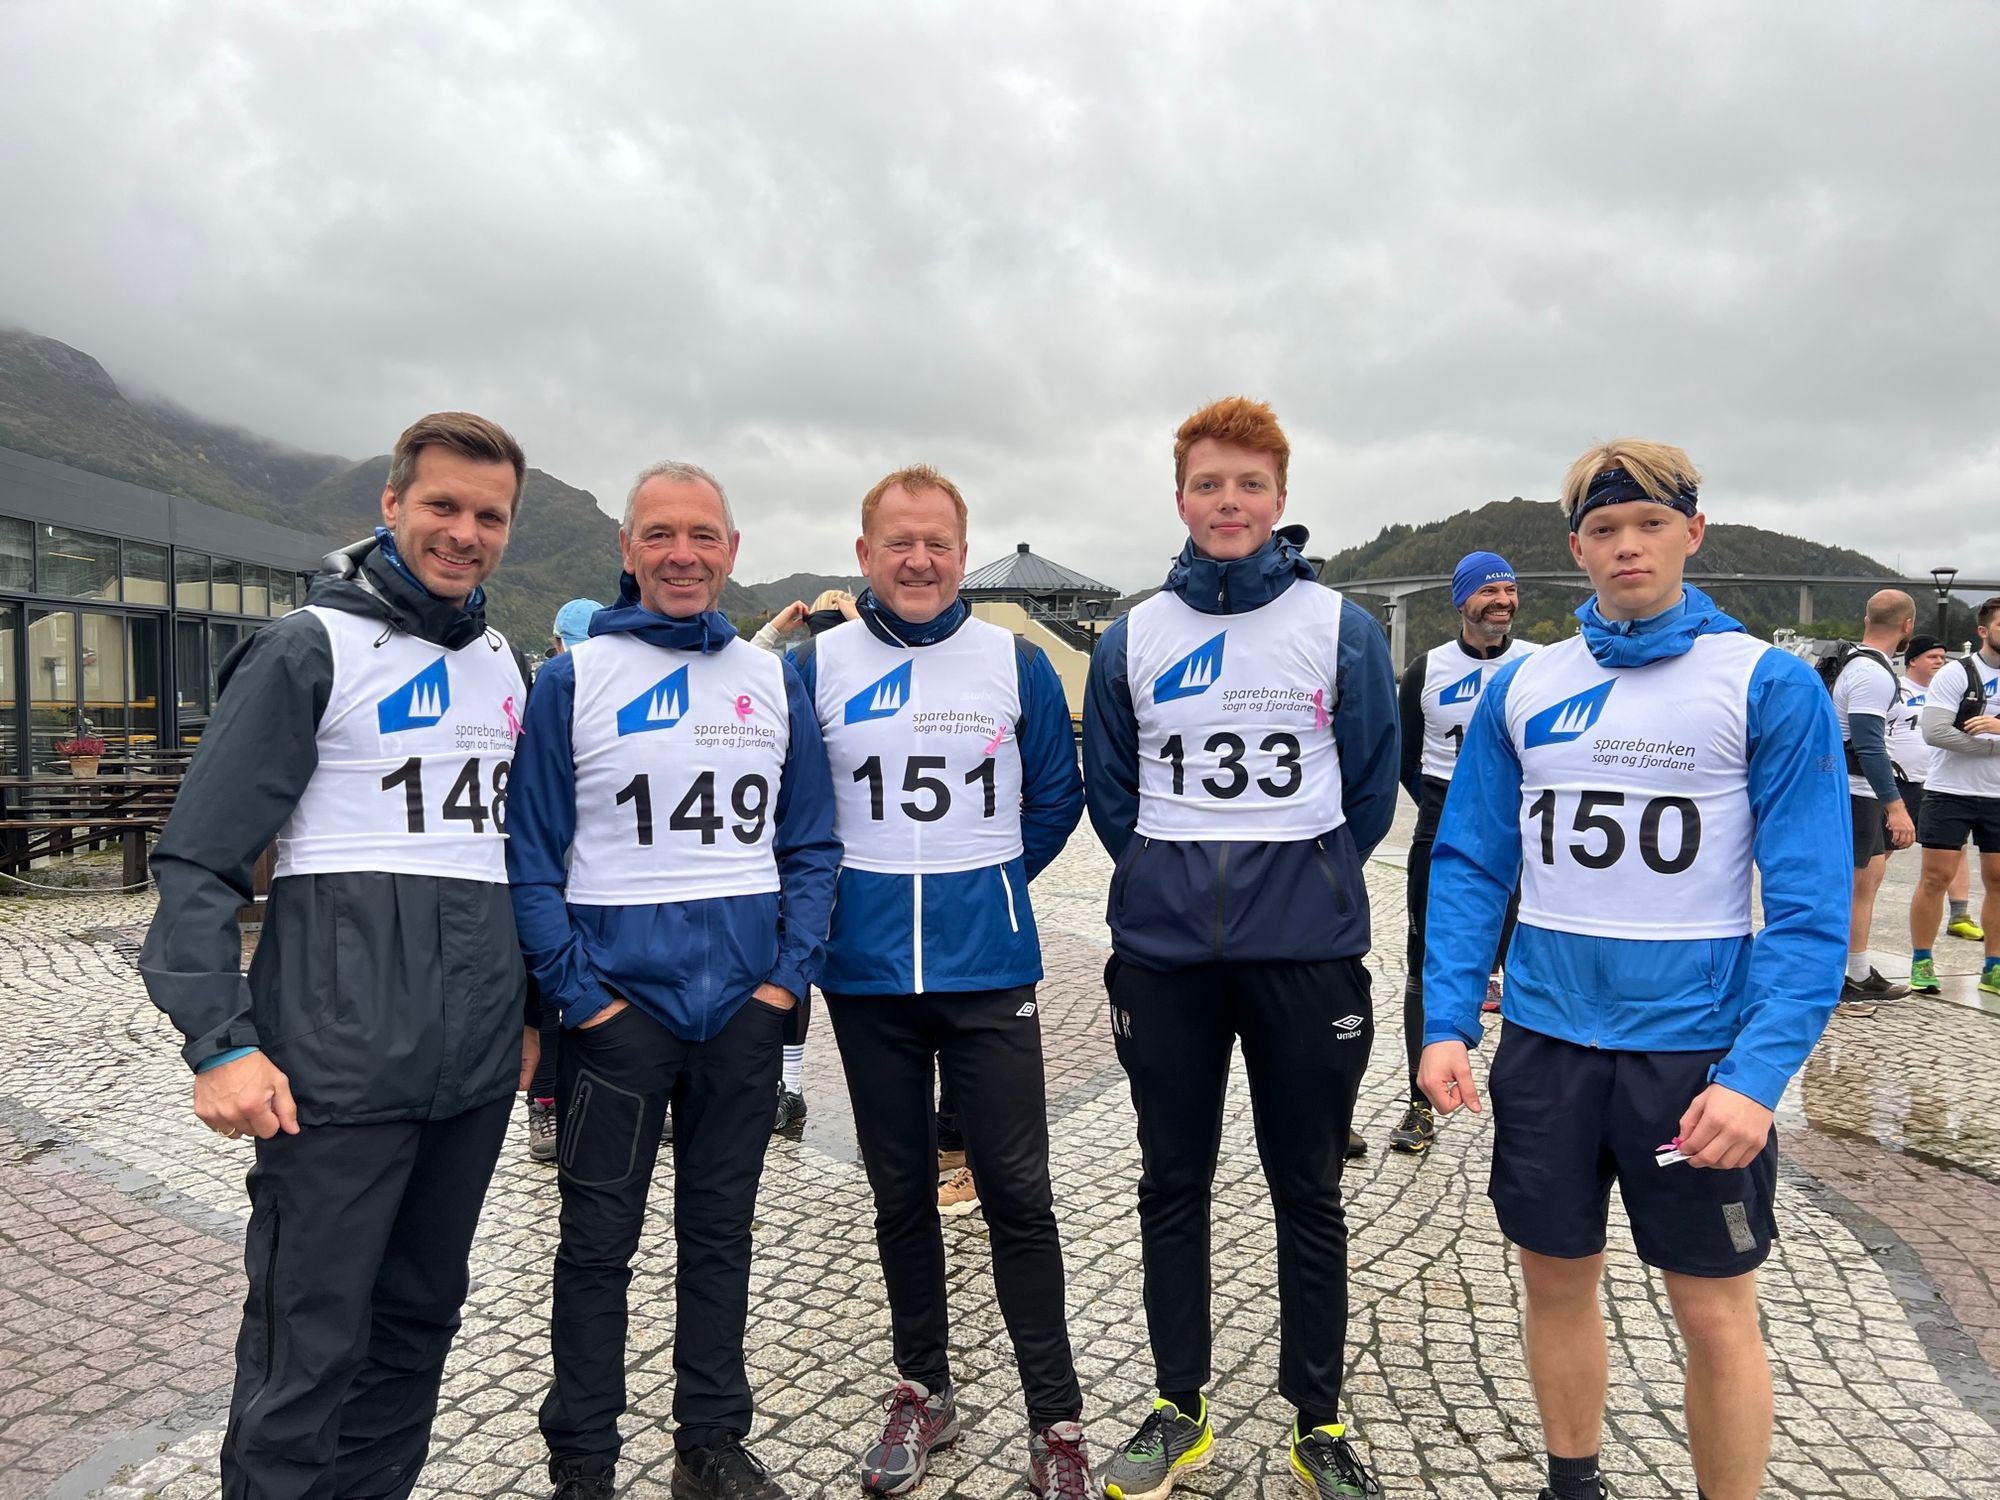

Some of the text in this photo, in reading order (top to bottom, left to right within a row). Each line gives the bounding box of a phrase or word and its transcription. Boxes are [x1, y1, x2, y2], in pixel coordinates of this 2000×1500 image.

[1221, 686, 1314, 702] sparebanken
[1221, 700, 1314, 713] sogn og fjordane
[912, 709, 995, 726] sparebanken
[693, 722, 776, 739] sparebanken
[913, 722, 997, 737] sogn og fjordane
[455, 740, 476, 751] sogn
[695, 736, 776, 750] sogn og fjordane
[1592, 737, 1697, 757] sparebanken
[1159, 731, 1303, 800] 133
[1591, 753, 1697, 772] sogn og fjordane
[381, 757, 511, 834] 148
[852, 755, 996, 823] 151
[615, 771, 769, 845] 149
[1528, 788, 1702, 875] 150
[1336, 1029, 1362, 1040] umbro
